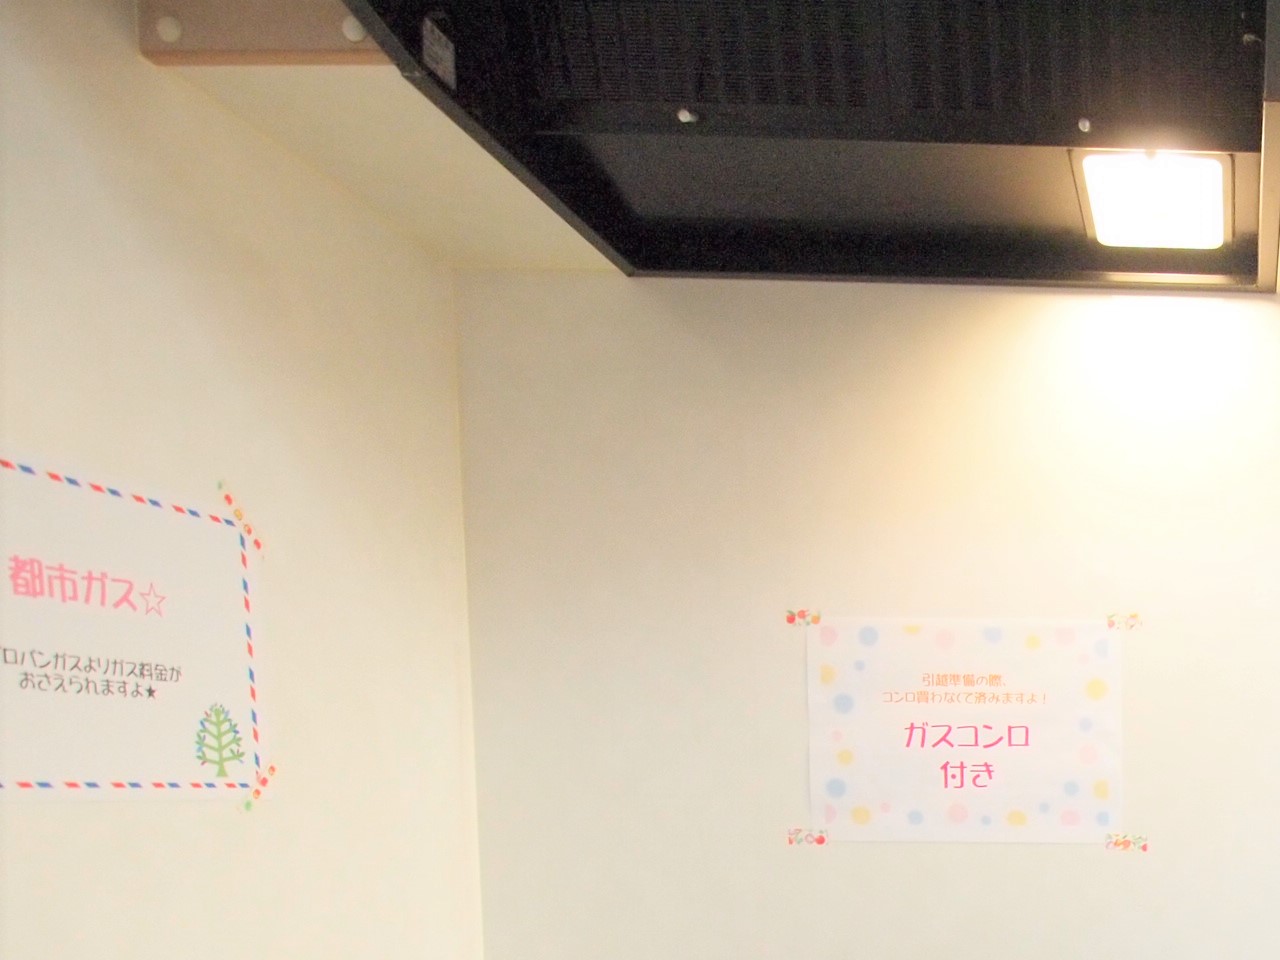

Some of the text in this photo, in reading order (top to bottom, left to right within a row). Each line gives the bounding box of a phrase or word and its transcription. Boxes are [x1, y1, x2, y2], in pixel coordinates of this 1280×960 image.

[0, 647, 182, 682] ロパンガスよりガス料金が
[904, 721, 1030, 749] ガスコンロ
[940, 760, 995, 789] 付き
